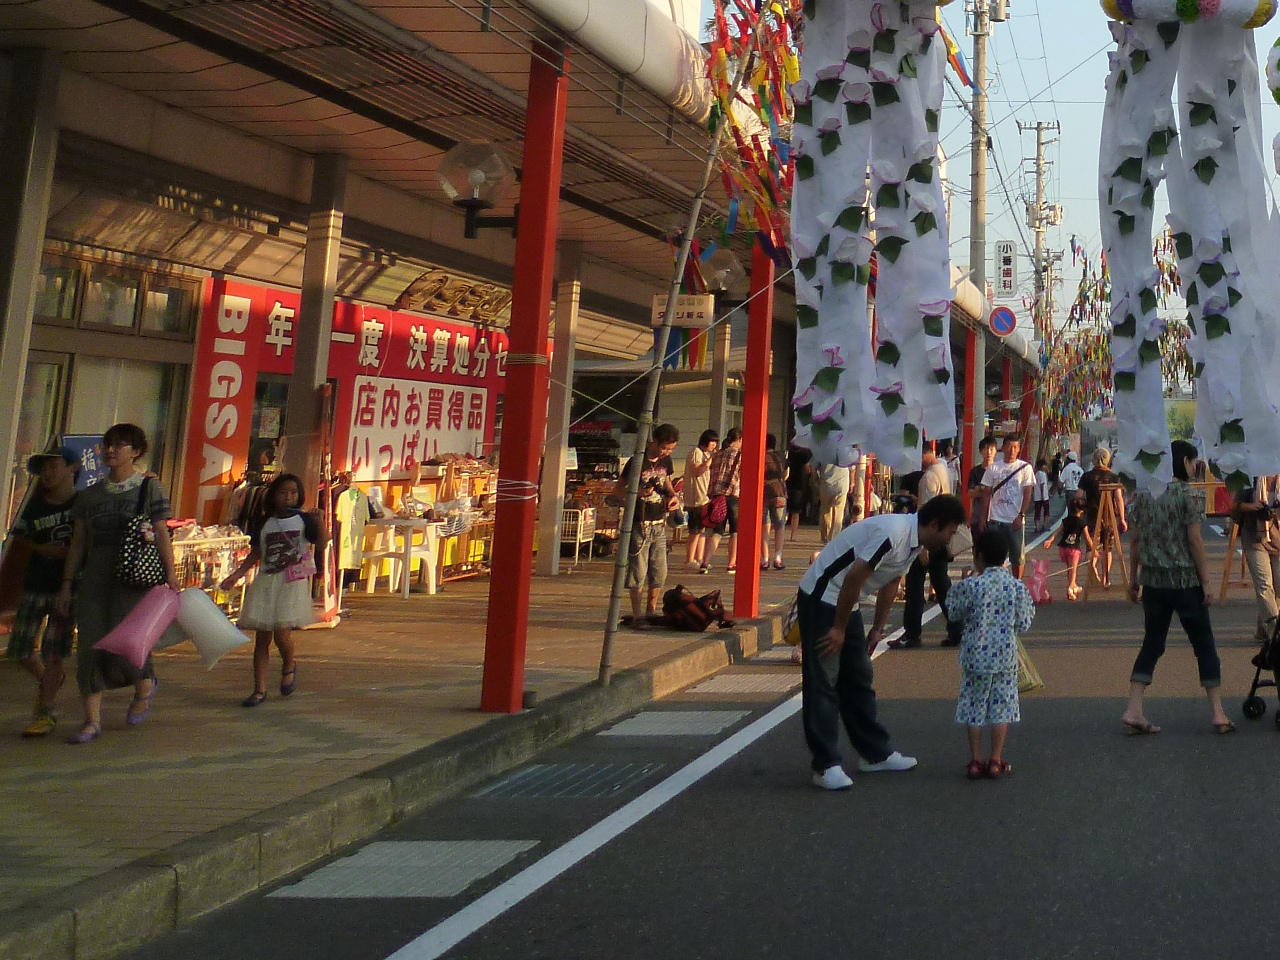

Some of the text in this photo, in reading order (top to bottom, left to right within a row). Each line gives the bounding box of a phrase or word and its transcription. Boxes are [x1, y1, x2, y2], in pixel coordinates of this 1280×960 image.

[353, 381, 484, 431] 店内お買得品
[350, 430, 438, 474] いっぱい
